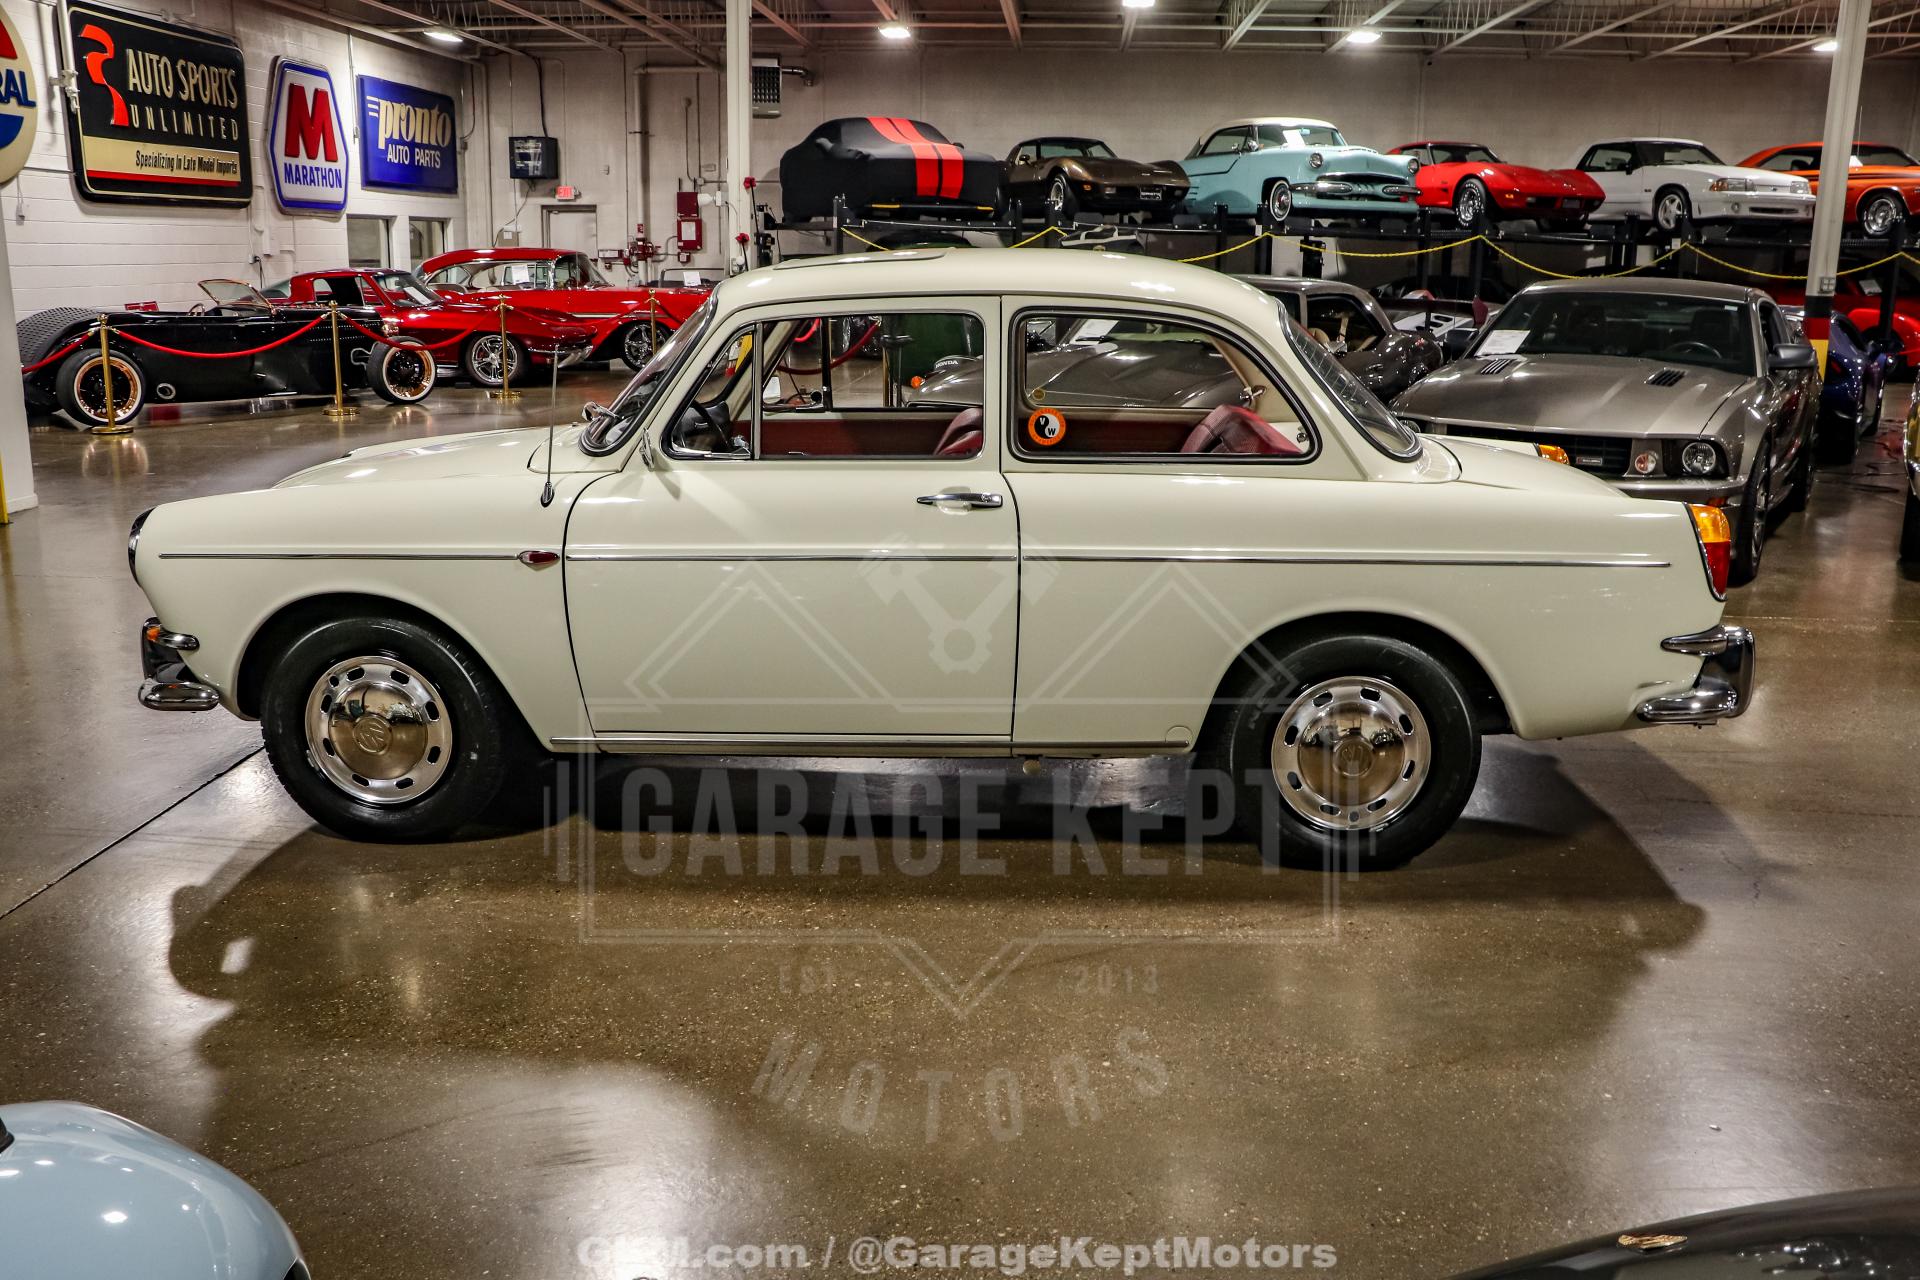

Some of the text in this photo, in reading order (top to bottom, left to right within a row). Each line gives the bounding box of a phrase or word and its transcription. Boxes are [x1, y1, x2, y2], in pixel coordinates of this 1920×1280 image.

[0, 68, 37, 107] AL
[127, 48, 238, 109] AUTO SPORTS
[130, 103, 239, 141] UNLIMITED
[284, 82, 339, 162] M
[377, 97, 452, 150] pronto
[135, 150, 175, 172] Specializing
[183, 155, 196, 171] Late
[283, 162, 343, 189] MARATHON
[387, 144, 441, 169] AUTO PARTS
[935, 360, 959, 369] HONDA
